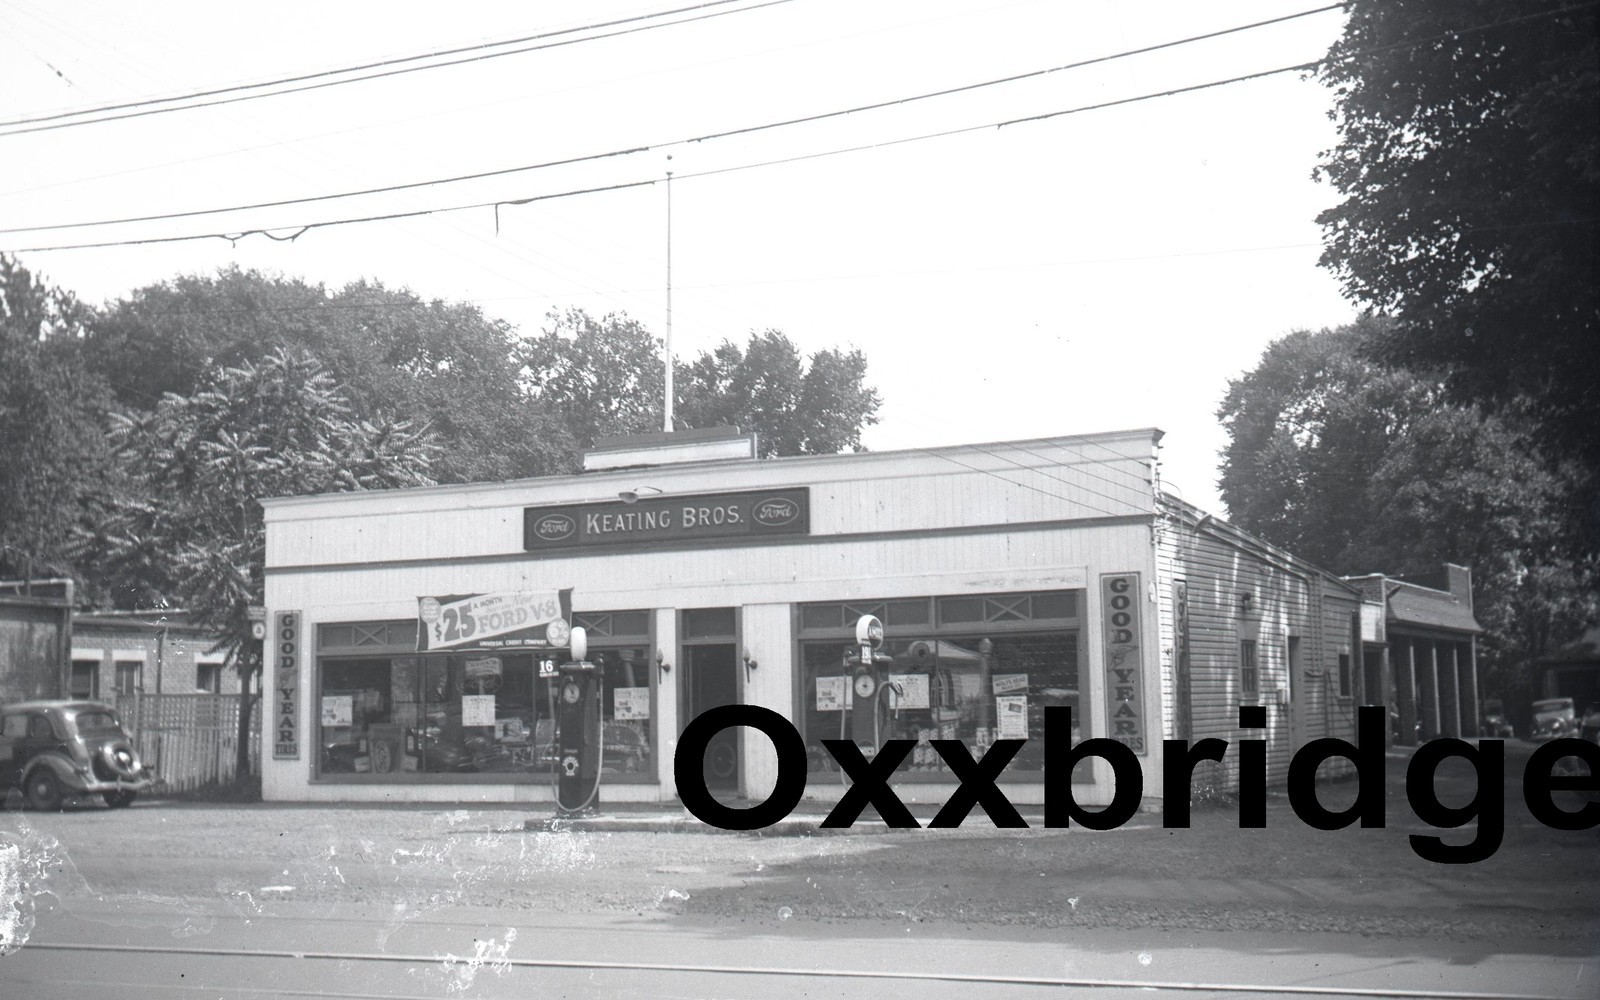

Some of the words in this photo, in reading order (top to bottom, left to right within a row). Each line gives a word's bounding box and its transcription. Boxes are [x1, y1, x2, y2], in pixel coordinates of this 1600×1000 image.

[759, 503, 792, 520] Ford
[540, 520, 569, 534] Ford
[586, 510, 671, 535] KEATING
[682, 505, 744, 529] BROS.
[480, 596, 503, 608] MONTH
[478, 607, 529, 634] FORD
[539, 659, 554, 673] 16
